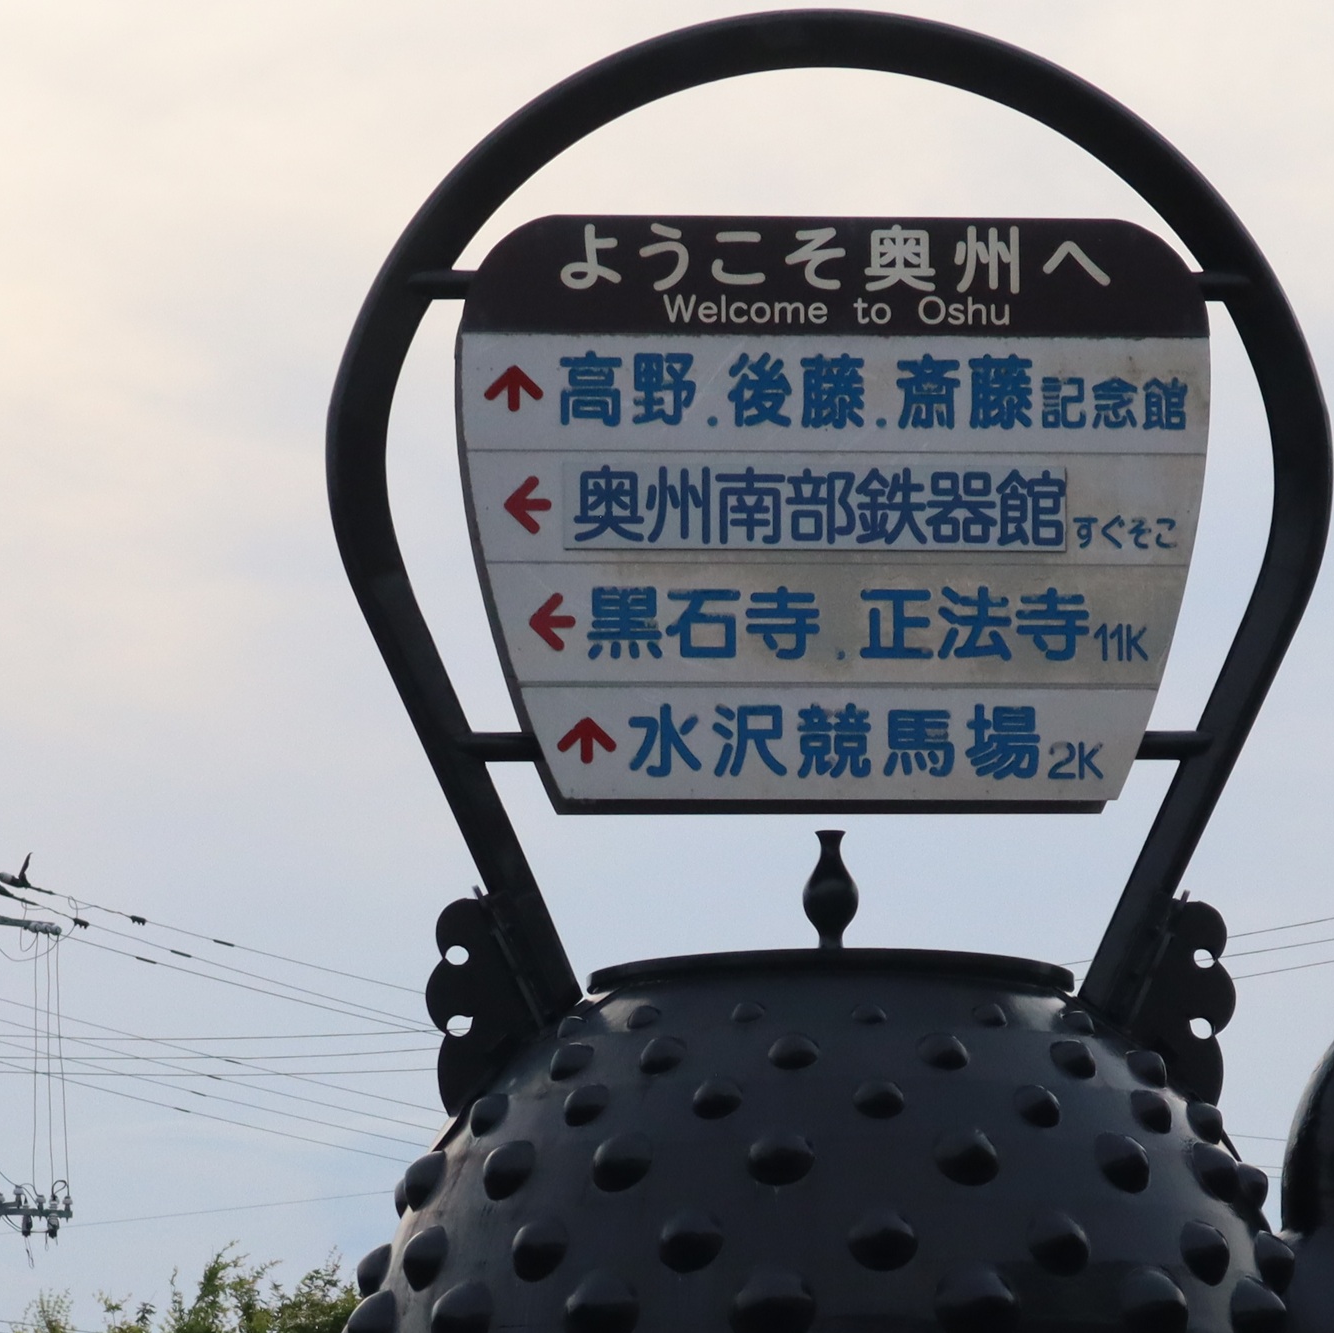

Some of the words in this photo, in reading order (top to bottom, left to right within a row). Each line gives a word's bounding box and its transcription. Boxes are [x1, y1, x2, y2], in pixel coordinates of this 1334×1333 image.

[559, 223, 1111, 294] ようこそ奥州へ
[663, 294, 828, 325] Welcome
[854, 297, 892, 325] to
[917, 295, 1011, 326] Oshu
[573, 464, 1066, 547] 奥州南部鉄器館
[1072, 514, 1178, 551] すぐそこ
[1093, 623, 1149, 663] 11K
[627, 702, 1041, 780] 水沢競馬場
[1048, 740, 1105, 781] 2K
